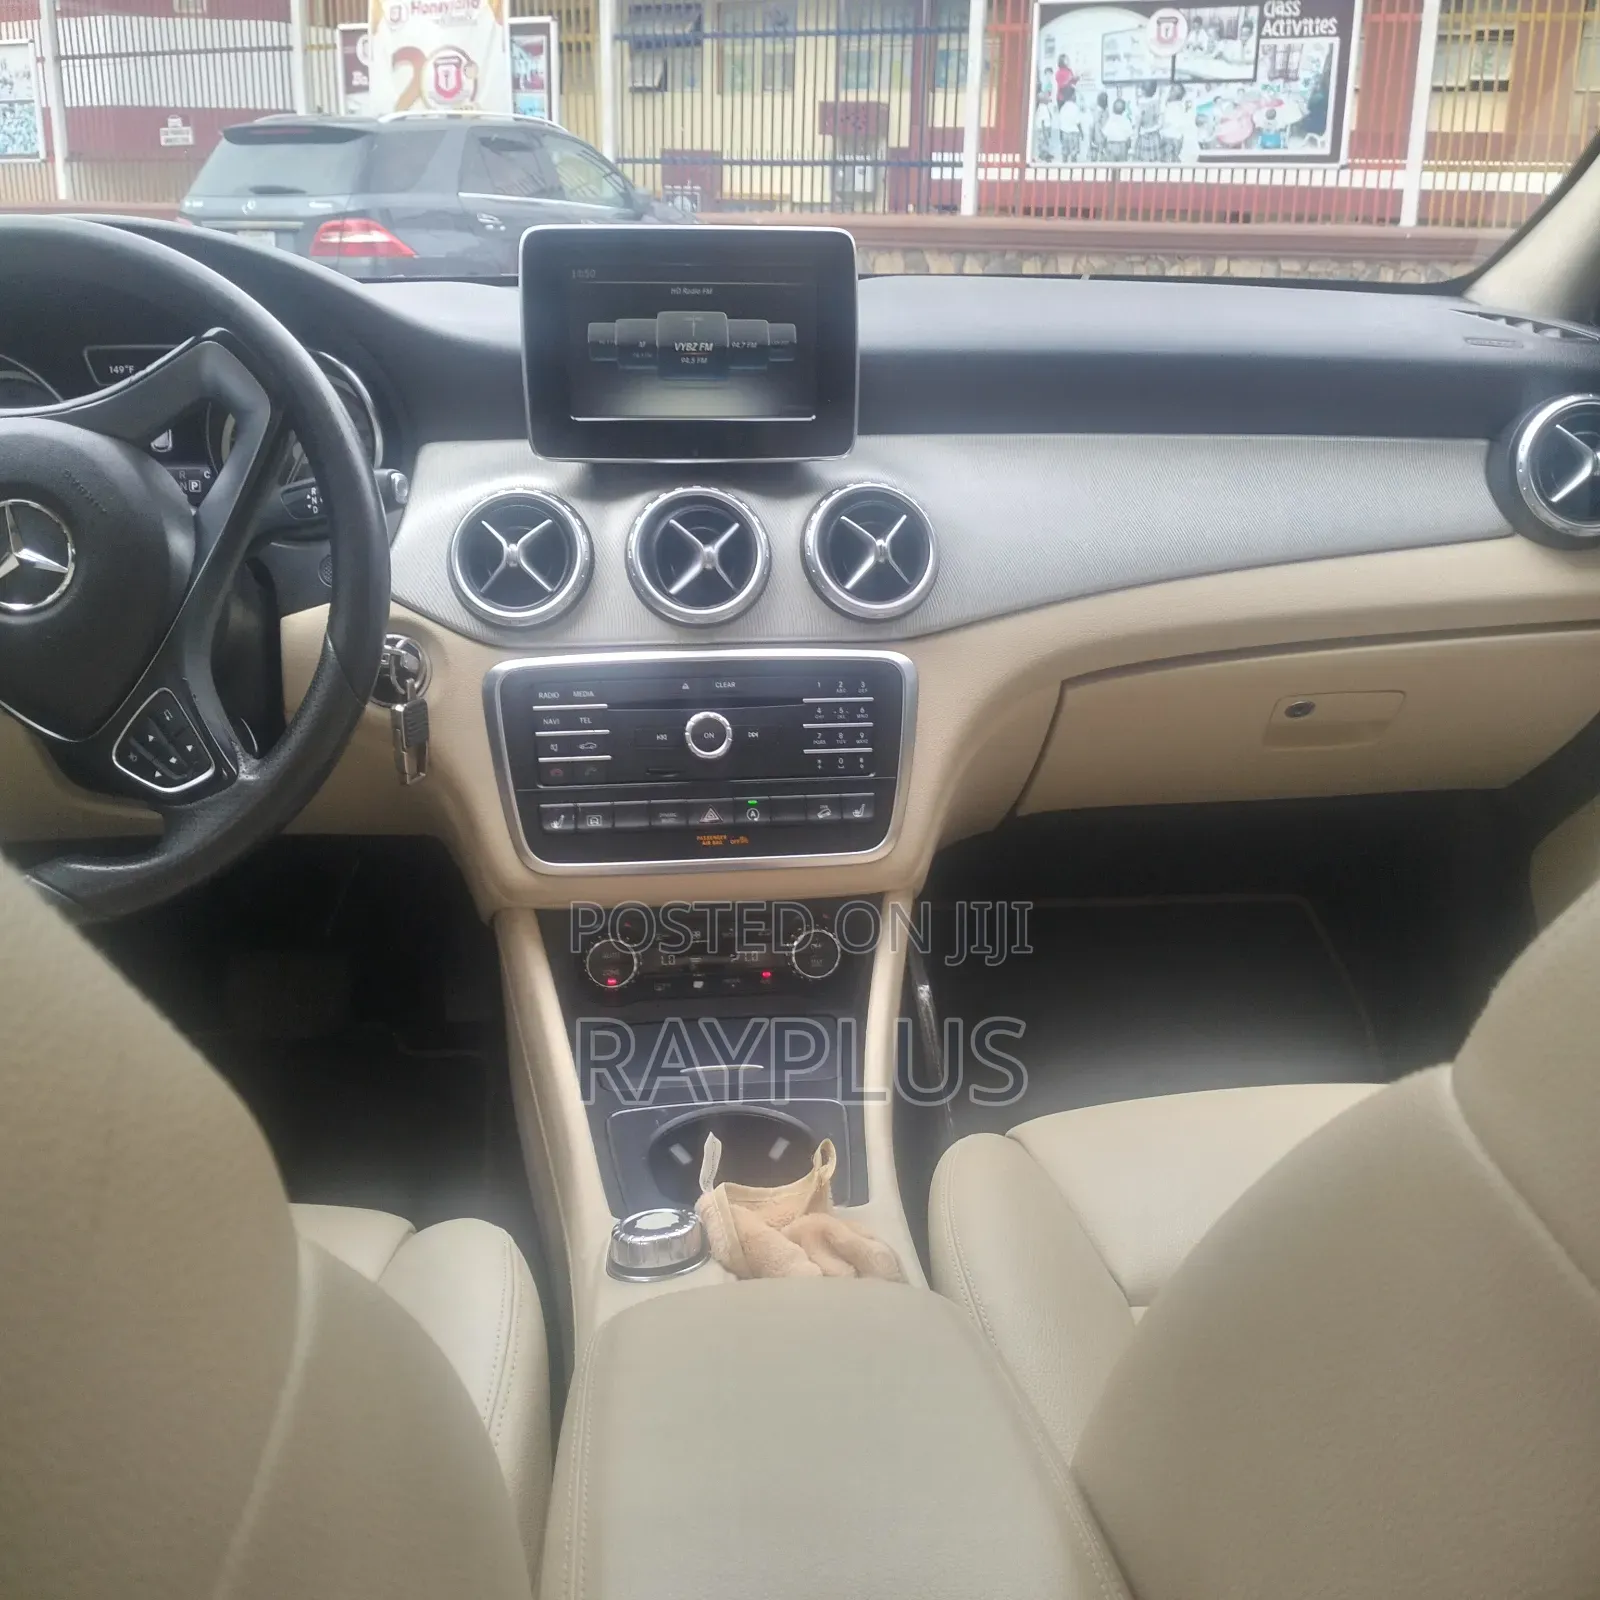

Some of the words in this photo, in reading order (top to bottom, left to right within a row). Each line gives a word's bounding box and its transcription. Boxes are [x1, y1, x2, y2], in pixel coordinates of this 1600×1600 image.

[1262, 17, 1337, 36] Activities
[674, 342, 698, 352] VYBZ
[699, 342, 714, 352] FM
[191, 481, 199, 491] P
[715, 681, 736, 689] CLEAR
[838, 680, 844, 688] 2
[860, 680, 866, 688] 3
[538, 691, 560, 699] RADIO
[573, 690, 595, 698] MEDIA
[816, 706, 822, 714] 4
[839, 706, 844, 714] 5
[703, 731, 715, 739] ON
[838, 732, 844, 740] 8
